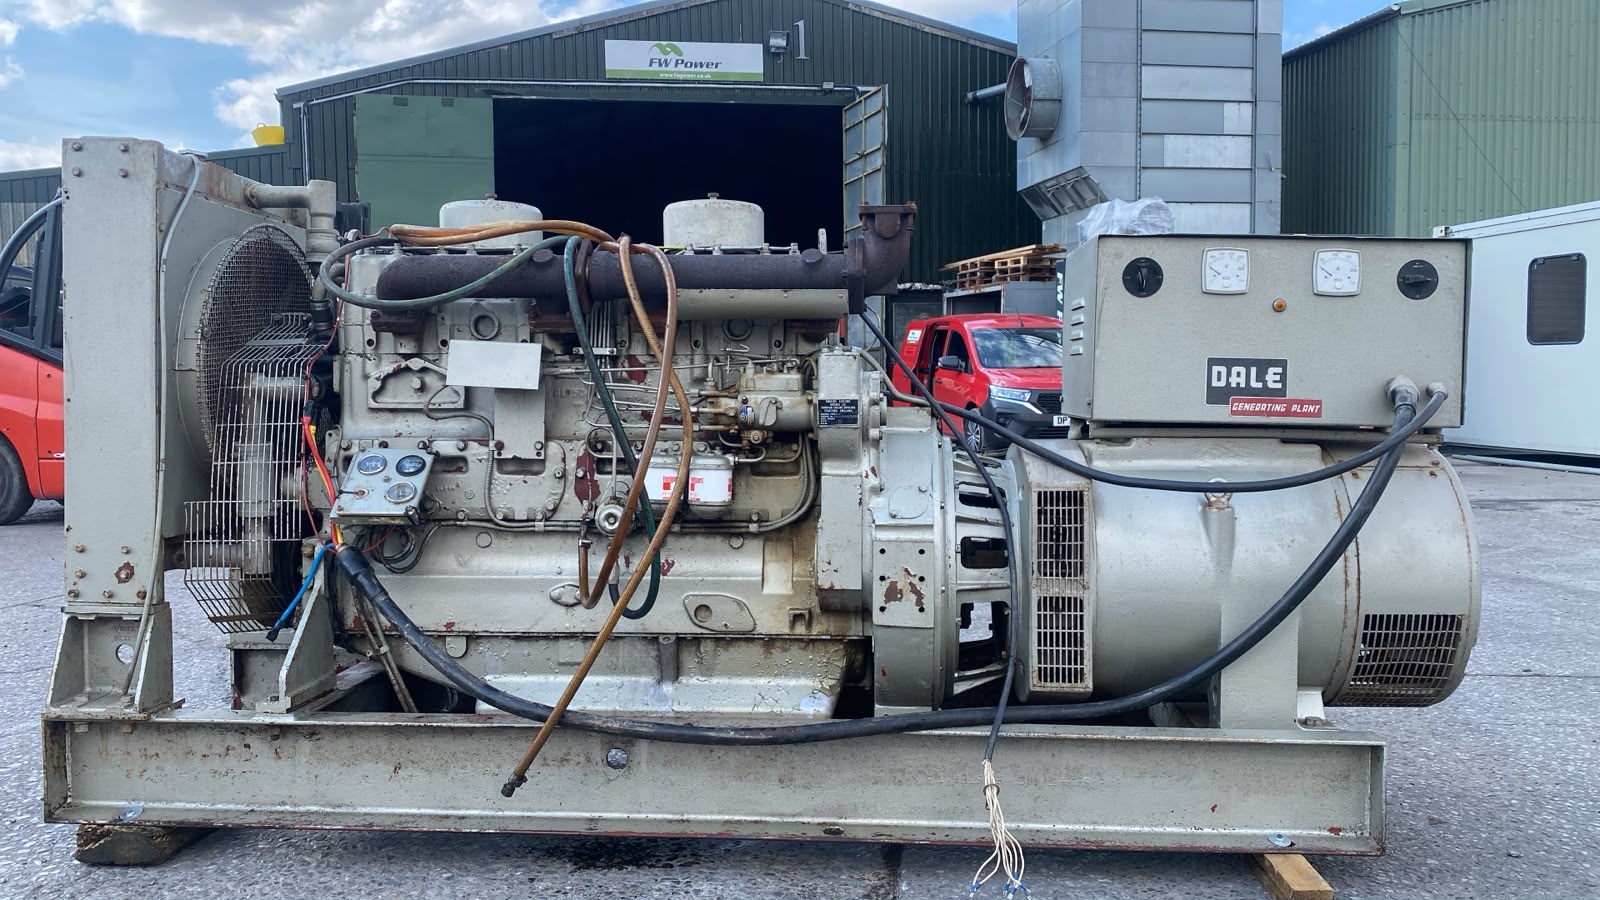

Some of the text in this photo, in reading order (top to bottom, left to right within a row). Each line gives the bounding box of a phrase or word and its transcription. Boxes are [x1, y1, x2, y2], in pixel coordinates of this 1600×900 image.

[793, 19, 810, 60] 1
[648, 57, 722, 69] FW Power
[659, 72, 712, 80] www.fwpower.co.uk
[1211, 365, 1283, 389] DALE
[1232, 402, 1321, 414] GENERATING PLANT
